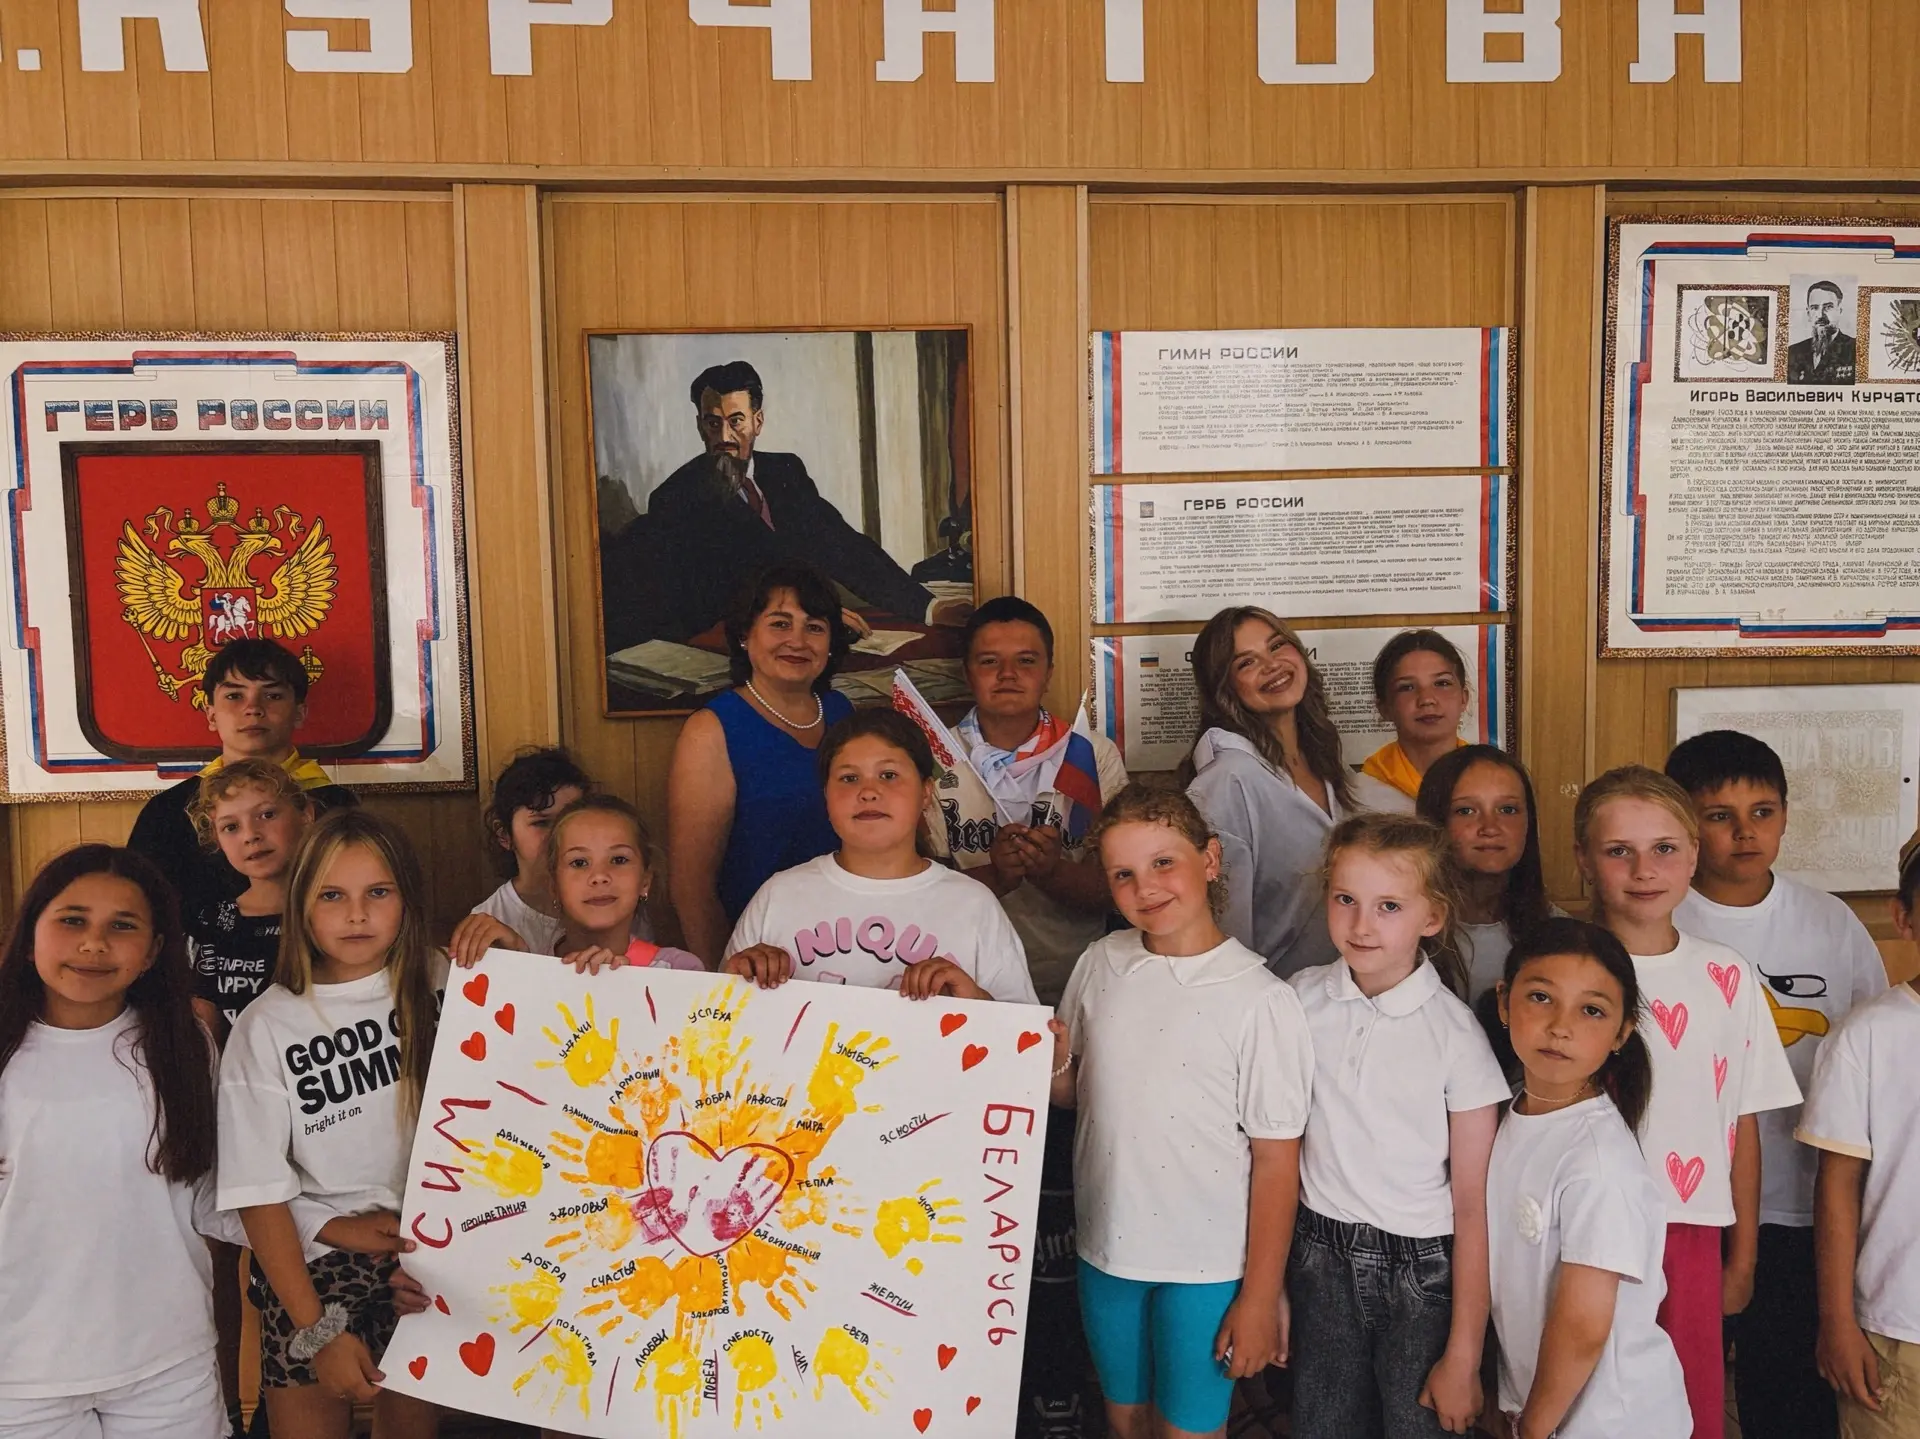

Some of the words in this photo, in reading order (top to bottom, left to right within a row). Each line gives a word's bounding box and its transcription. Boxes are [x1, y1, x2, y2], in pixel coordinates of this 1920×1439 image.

[0, 0, 1741, 84] .КУРЧАТОВА
[1158, 348, 1211, 360] ГИМН
[1220, 346, 1298, 359] РОССИИ
[1690, 390, 1739, 402] Игорь
[1746, 389, 1843, 402] Васильевич
[44, 399, 178, 432] ГЕРБ
[197, 399, 390, 431] РОССИИ
[1184, 498, 1226, 511] ГЕРБ
[1236, 497, 1304, 509] РОССИИ
[940, 798, 997, 853] Rea
[790, 914, 942, 967] NIQU
[688, 1006, 733, 1023] УСПЕХА
[285, 1018, 383, 1076] GOOD
[559, 1020, 592, 1059] УДАЧИ
[834, 1041, 881, 1070] УЛЫБОК
[694, 1089, 733, 1109] ДОБРА
[304, 1113, 337, 1136] bright
[337, 1108, 347, 1122] it
[348, 1105, 362, 1117] on
[795, 1119, 826, 1133] МИРА
[879, 1112, 929, 1145] ЯСНОСТИ
[496, 1128, 551, 1169] ДВИЖЕНИЯ
[411, 1098, 491, 1249] СИМ
[797, 1176, 835, 1191] ТЕПЛА
[461, 1201, 527, 1233] ПРОЦВЕТАНИЯ
[549, 1197, 609, 1222] ЗДОРОВЬЯ
[917, 1195, 937, 1222] УЮТА
[983, 1104, 1036, 1346] БЕЛАРУСЬ
[753, 1228, 822, 1260] ВДОХНОВЕНИЯ
[521, 1251, 567, 1283] ДОБРА
[591, 1260, 637, 1289] СЧАСТЬЯ
[690, 1305, 730, 1319] ЗАКАТОВ
[556, 1318, 598, 1367] ПОЗИТИВА
[634, 1329, 669, 1368] ЛЮБВИ
[722, 1328, 774, 1351] СМЕЛОСТИ
[842, 1323, 870, 1346] СВЕТА
[793, 1350, 808, 1374] СИЛ
[703, 1358, 717, 1400] ПОБЕД
